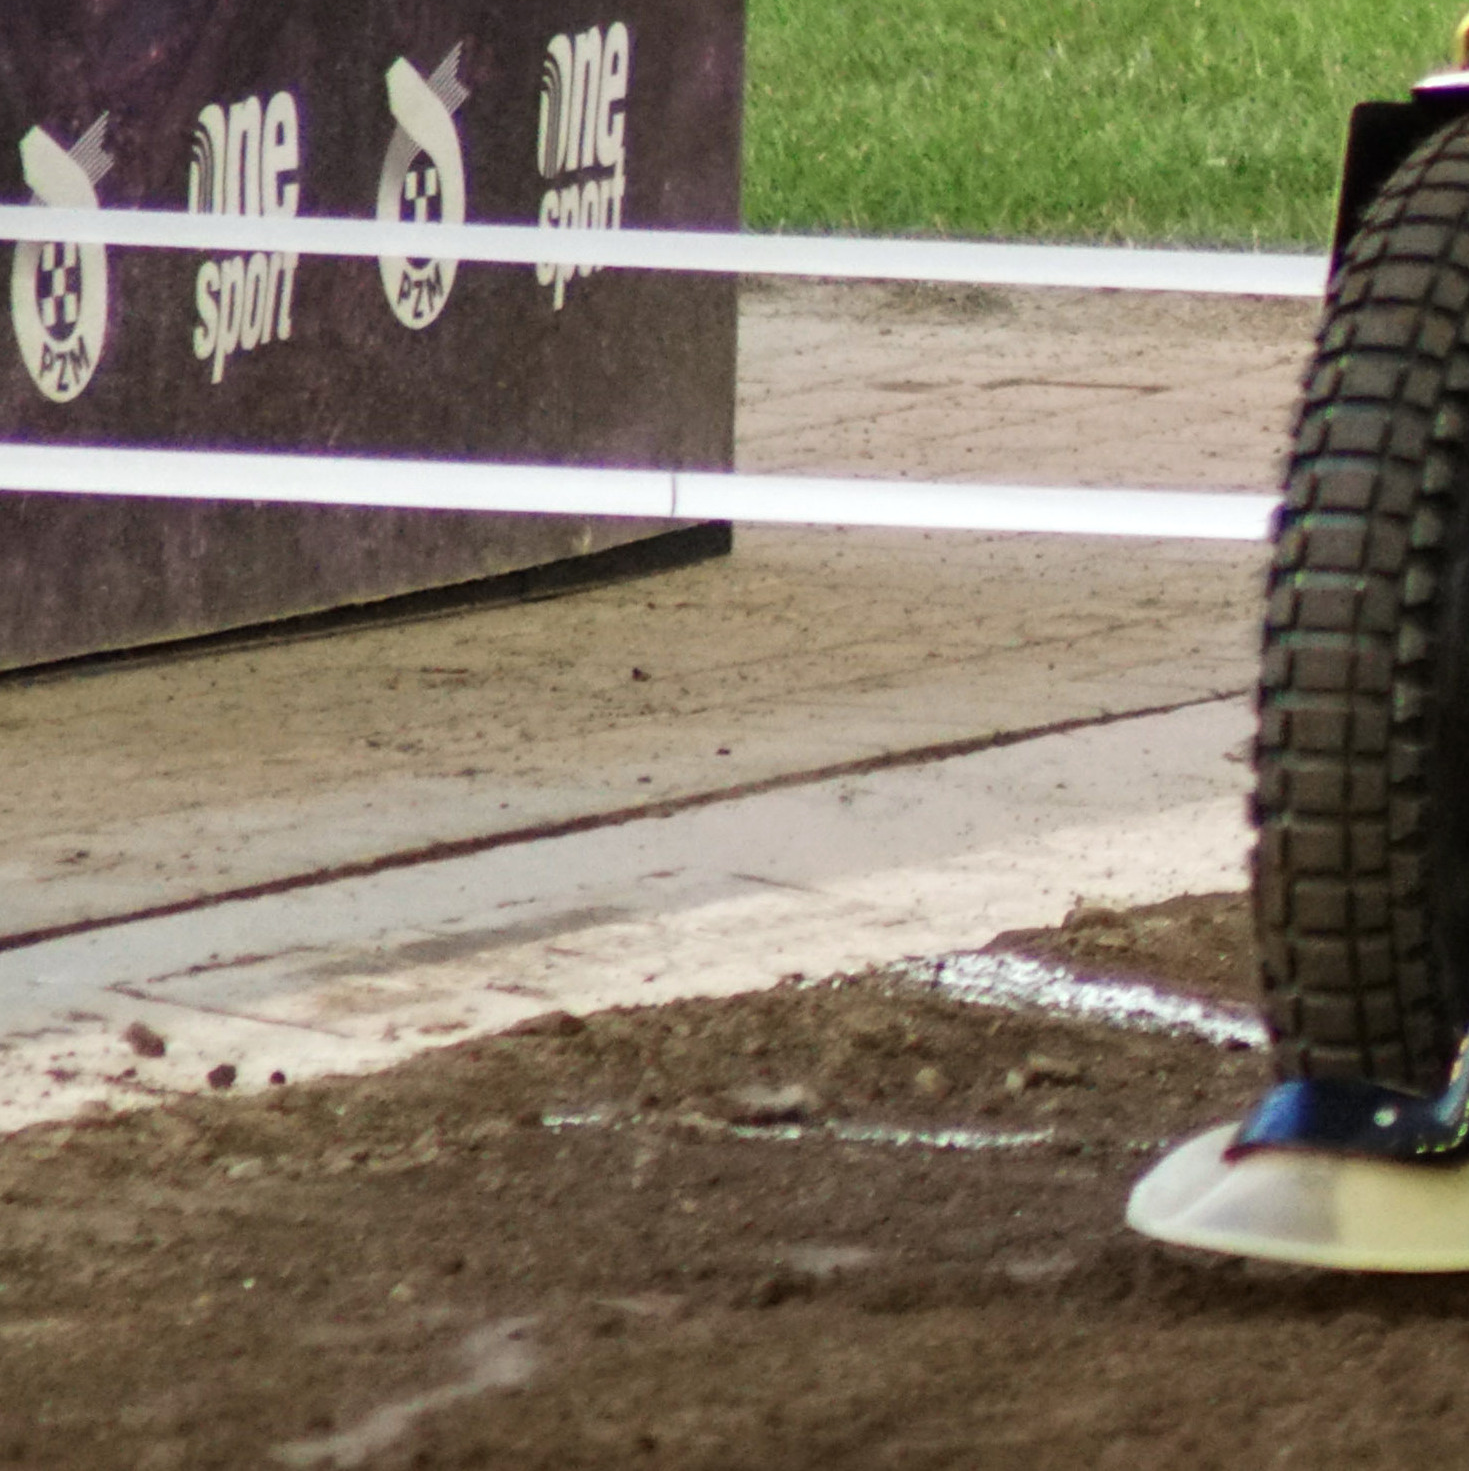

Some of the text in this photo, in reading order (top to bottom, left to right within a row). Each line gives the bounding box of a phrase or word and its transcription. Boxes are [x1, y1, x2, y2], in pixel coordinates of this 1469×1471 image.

[193, 251, 300, 385] sport
[400, 266, 446, 320] PZM
[40, 335, 90, 391] PZM
